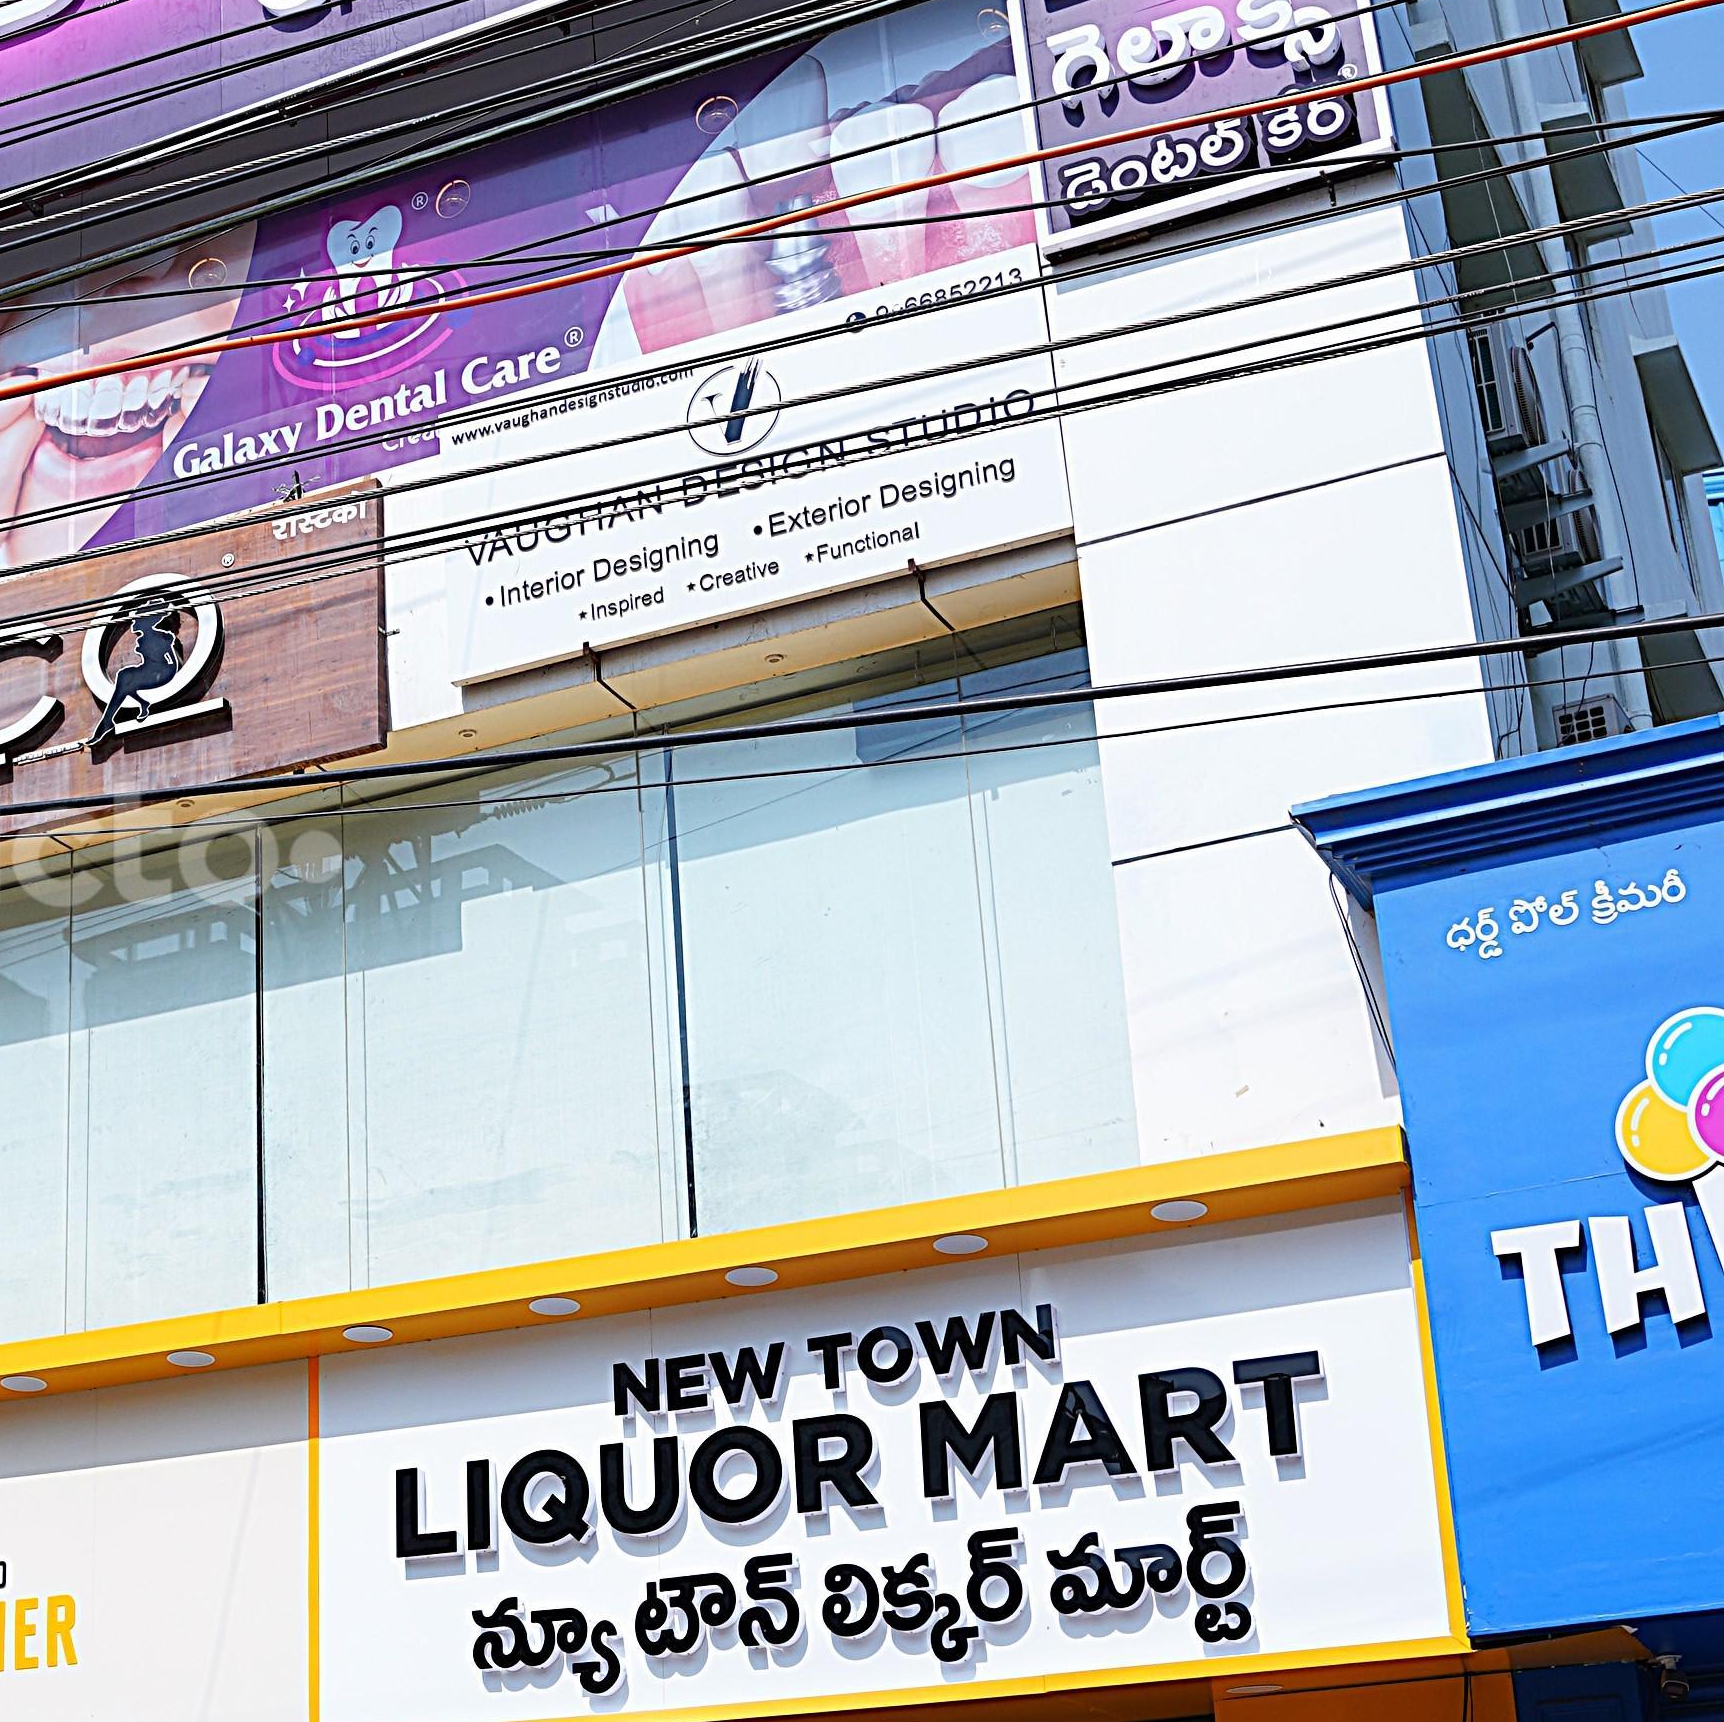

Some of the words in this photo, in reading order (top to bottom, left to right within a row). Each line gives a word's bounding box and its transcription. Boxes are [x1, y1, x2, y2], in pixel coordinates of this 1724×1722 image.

[172, 420, 301, 478] Galaxy
[315, 367, 447, 443] Dental
[460, 345, 561, 398] Care
[769, 494, 872, 539] Exterior
[879, 454, 1016, 512] Designing
[500, 565, 585, 608] Interior
[593, 531, 720, 586] Designing
[700, 558, 780, 594] Creative
[817, 521, 921, 565] Functional
[591, 586, 665, 624] Inspired
[611, 1341, 788, 1417] NEW
[807, 1304, 1058, 1396] TOWN
[395, 1412, 876, 1561] LIQUOR
[918, 1349, 1320, 1501] MART
